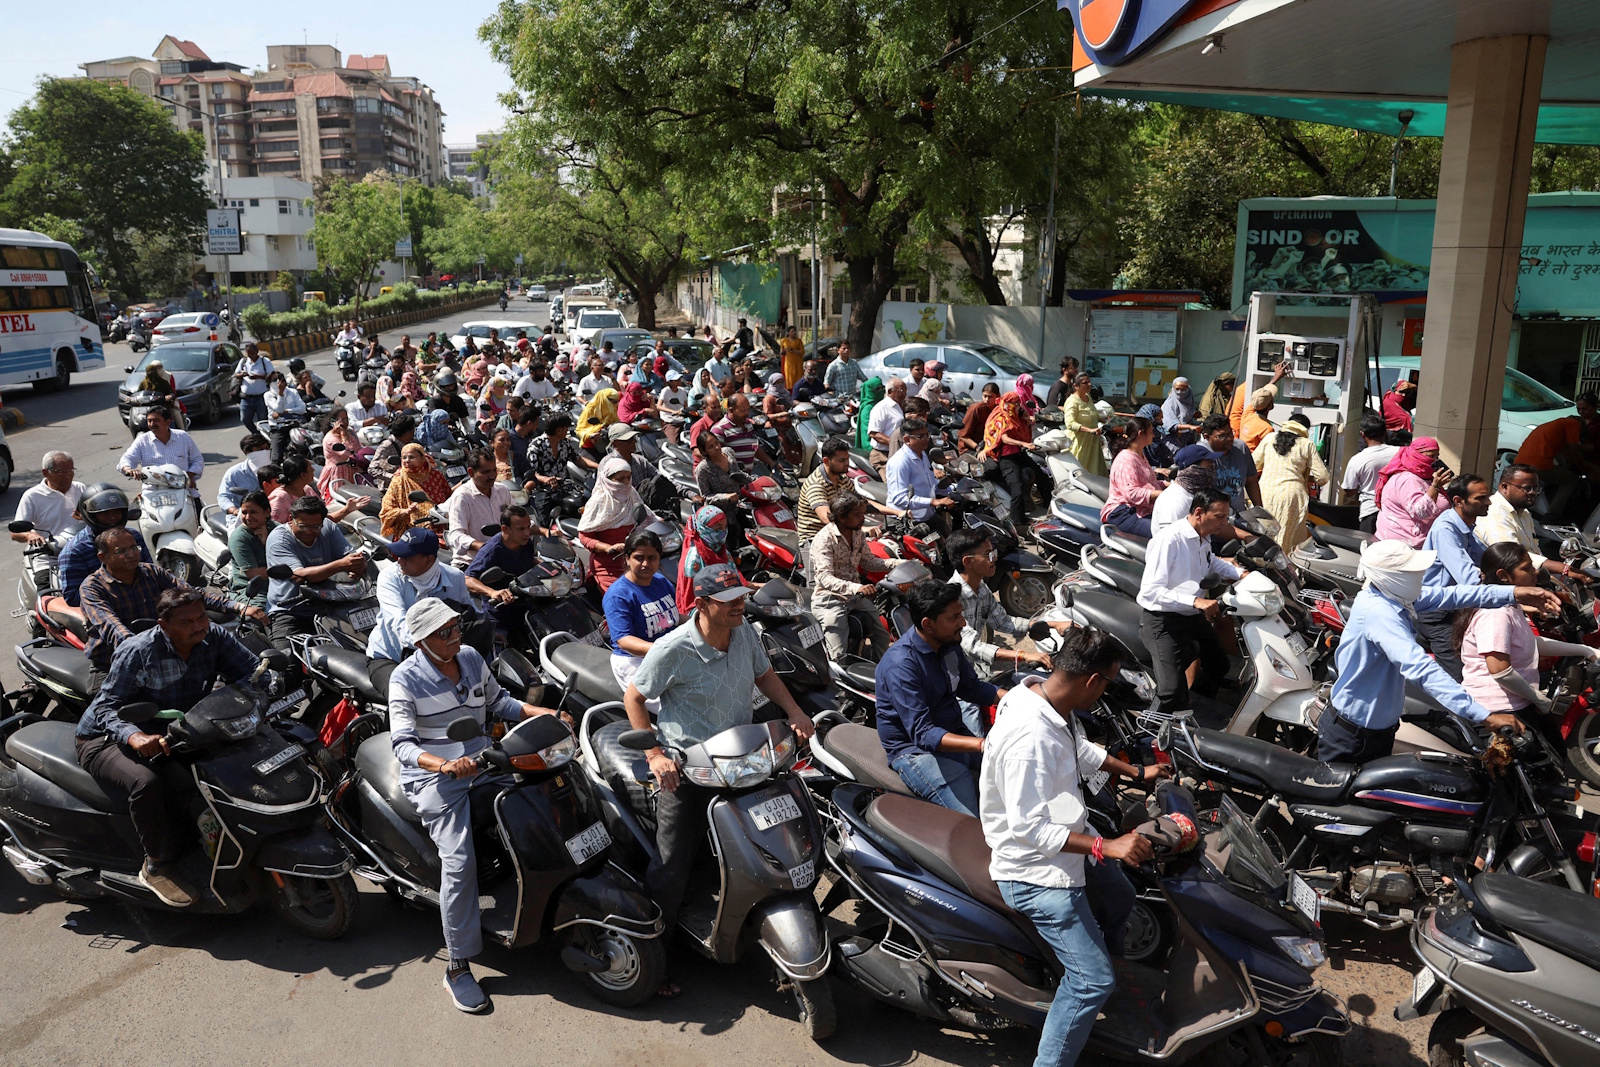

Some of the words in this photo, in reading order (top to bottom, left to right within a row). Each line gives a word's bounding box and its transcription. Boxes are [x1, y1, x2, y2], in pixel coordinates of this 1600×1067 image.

[1273, 210, 1333, 219] OPERATION
[209, 228, 237, 236] CHITRA
[1546, 245, 1586, 258] भारत
[1552, 259, 1571, 275] तो
[764, 797, 788, 813] GJ01
[763, 805, 799, 827] NJ8279
[580, 826, 602, 845] GJ01
[580, 833, 610, 859] DM6686
